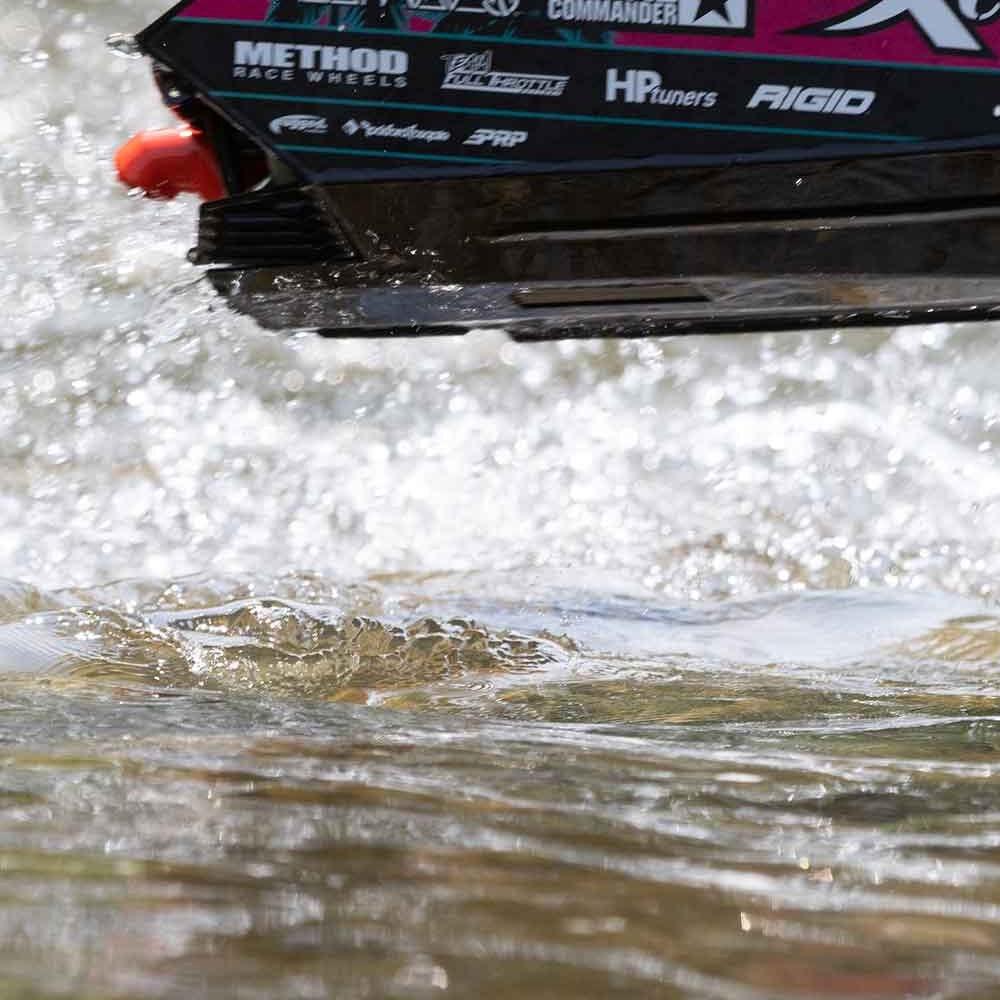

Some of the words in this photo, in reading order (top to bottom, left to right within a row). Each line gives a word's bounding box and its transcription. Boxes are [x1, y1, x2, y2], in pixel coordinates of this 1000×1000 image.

[547, 0, 678, 25] COMMANDER
[234, 41, 408, 75] METHOD
[233, 66, 295, 81] RACE
[306, 70, 408, 88] WHEELS
[746, 84, 876, 115] RIGID
